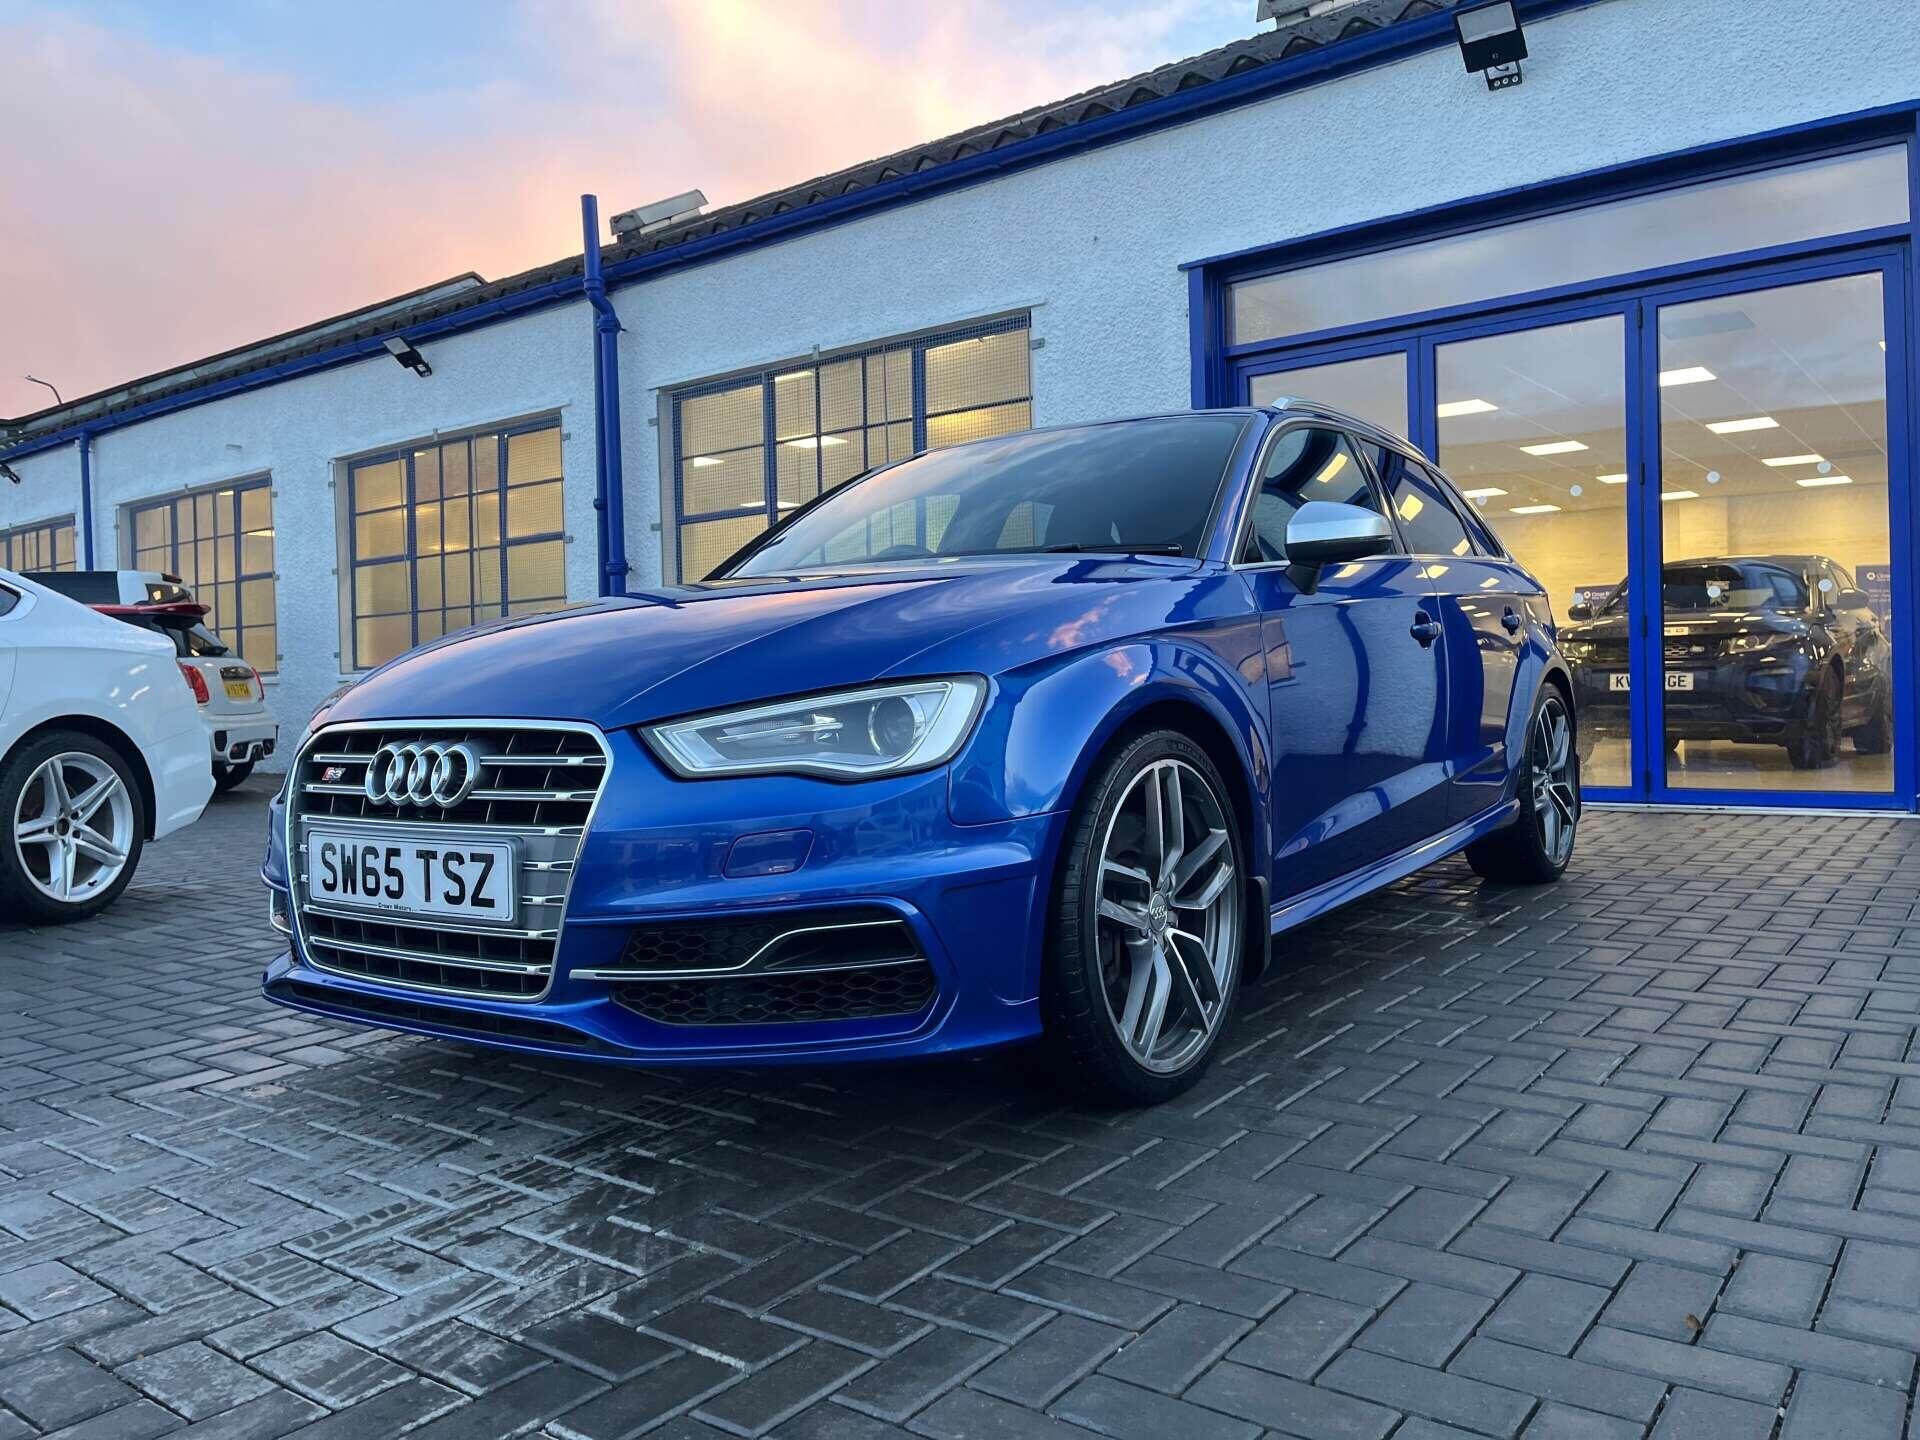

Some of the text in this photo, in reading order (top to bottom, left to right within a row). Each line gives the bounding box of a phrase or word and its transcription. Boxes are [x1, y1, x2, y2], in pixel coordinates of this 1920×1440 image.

[1665, 675, 1687, 688] GE
[320, 842, 496, 909] SW65 TSZ
